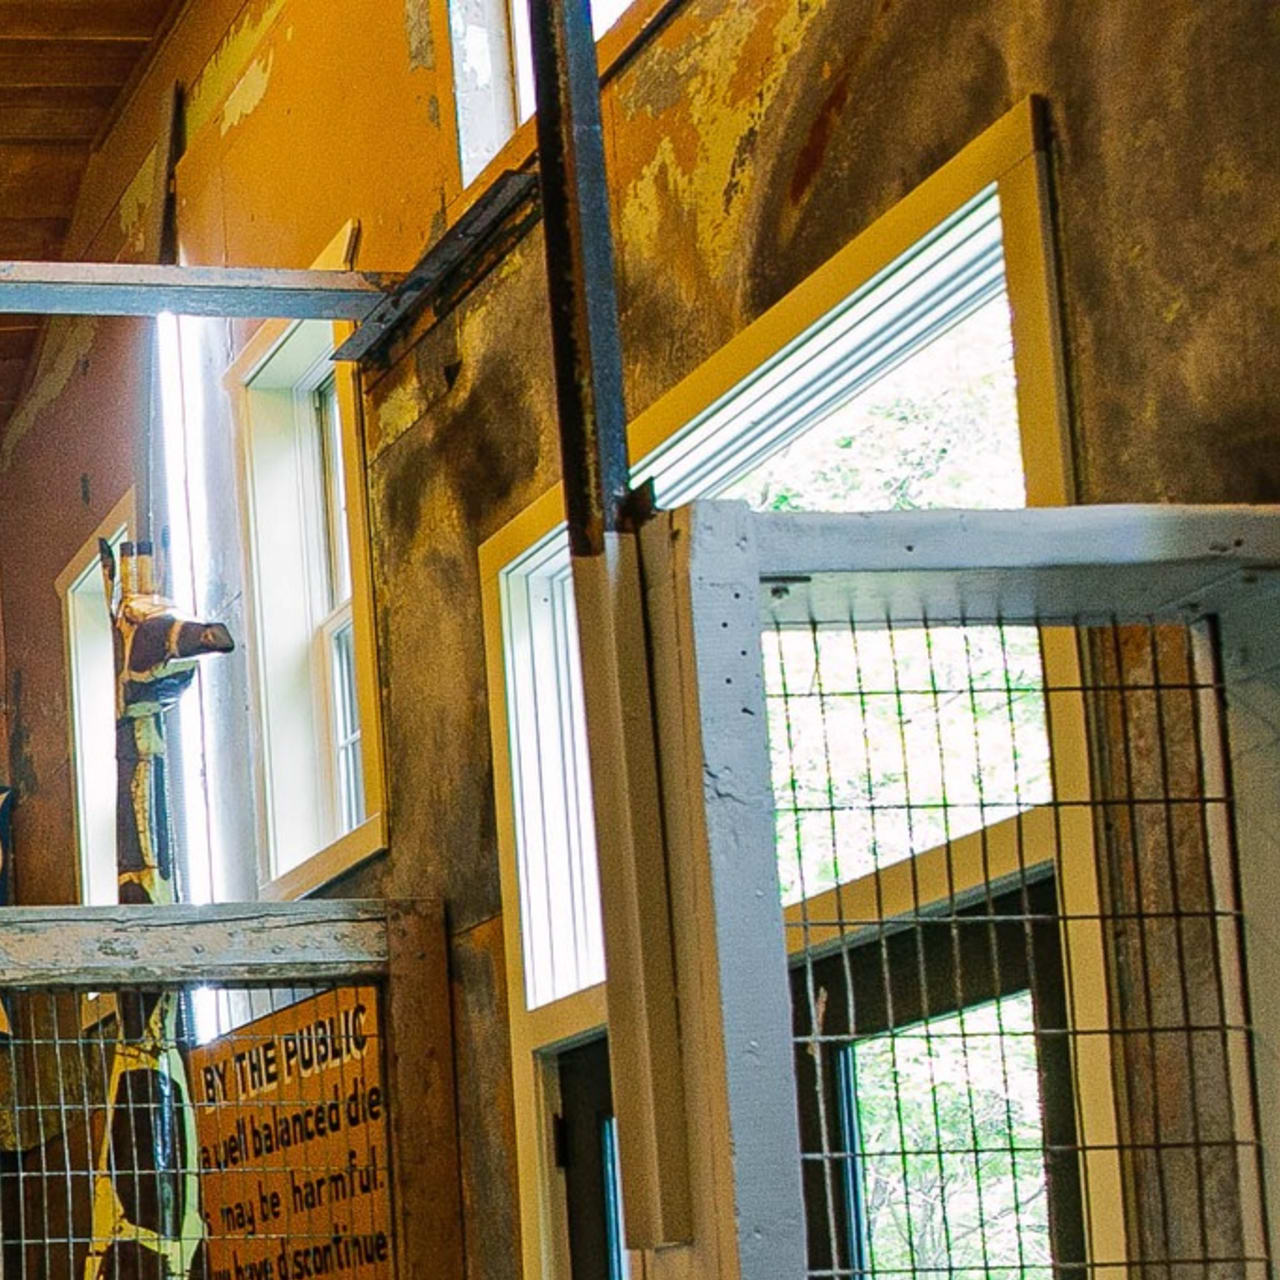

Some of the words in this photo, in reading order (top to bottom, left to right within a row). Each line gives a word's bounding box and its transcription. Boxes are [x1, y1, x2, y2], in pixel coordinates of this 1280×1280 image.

[202, 1060, 227, 1112] BY
[233, 1038, 278, 1100] THE
[281, 1004, 368, 1085] PUBLIC
[251, 1084, 340, 1158] balanced
[221, 1199, 257, 1236] may
[258, 1180, 281, 1223] be
